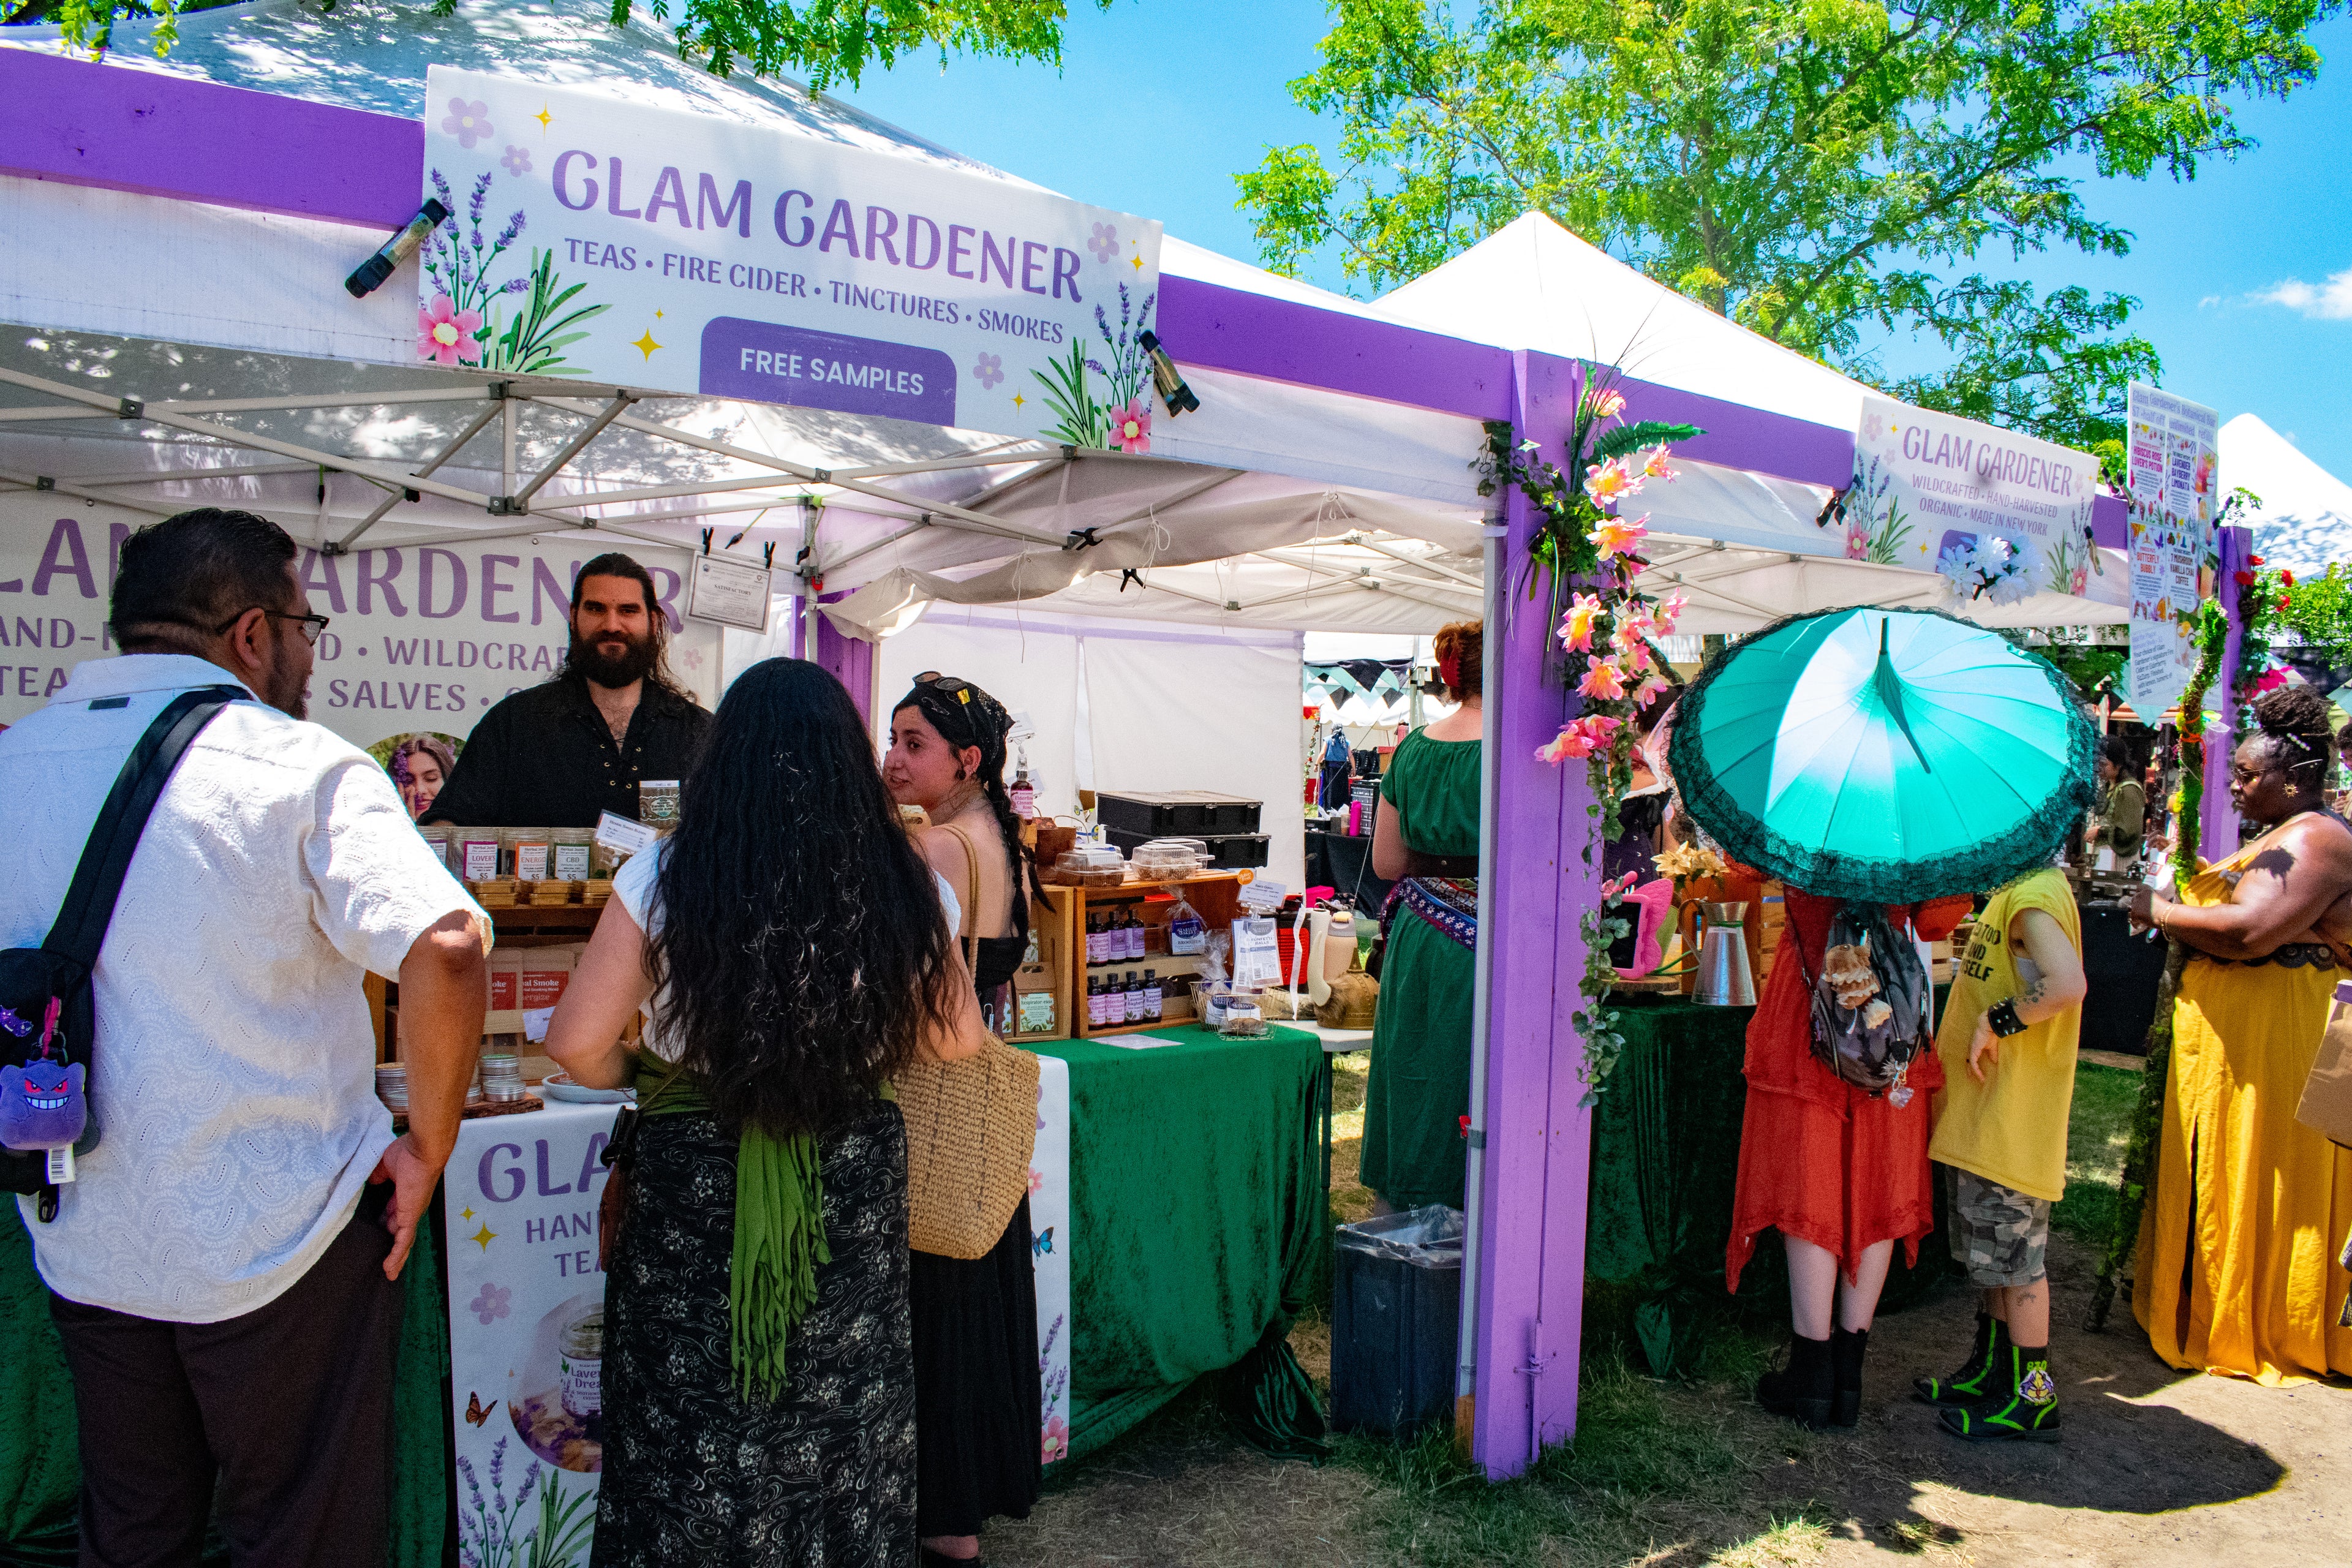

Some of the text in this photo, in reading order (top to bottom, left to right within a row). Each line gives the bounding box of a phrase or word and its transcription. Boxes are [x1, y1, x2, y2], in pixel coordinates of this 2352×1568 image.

[552, 149, 1082, 303] GLAM GARDENER
[565, 238, 1063, 344] TEAS FIRE CIDER TINCTURES SMOKES
[741, 347, 924, 396] FREE SAMPLES
[2133, 390, 2149, 406] Glam
[1904, 426, 2072, 497] GLAM GARDENER
[2134, 446, 2162, 462] HIBISCUS ROSE
[2172, 458, 2190, 470] LAVENDER
[2149, 461, 2163, 473] POTION
[2172, 468, 2190, 480] BAYBERRY
[1912, 473, 2057, 518] WILDCRAFTED HAND-HARVESTED
[1920, 497, 2048, 536] ORGANIC MADE IN NEW YORK
[2137, 552, 2159, 564] BUTTERFLY
[2170, 564, 2194, 576] VANILLA CHAI
[2174, 554, 2193, 565] MUSHROOM
[714, 584, 752, 595] SATISFACTORY
[2176, 576, 2188, 586] COFFEE
[383, 636, 568, 672] WILDCRAF
[0, 665, 68, 698] TEA
[328, 679, 466, 712] SALVES
[478, 1131, 612, 1202] GLA
[526, 1211, 601, 1244] HAN
[575, 1378, 600, 1389] Drea
